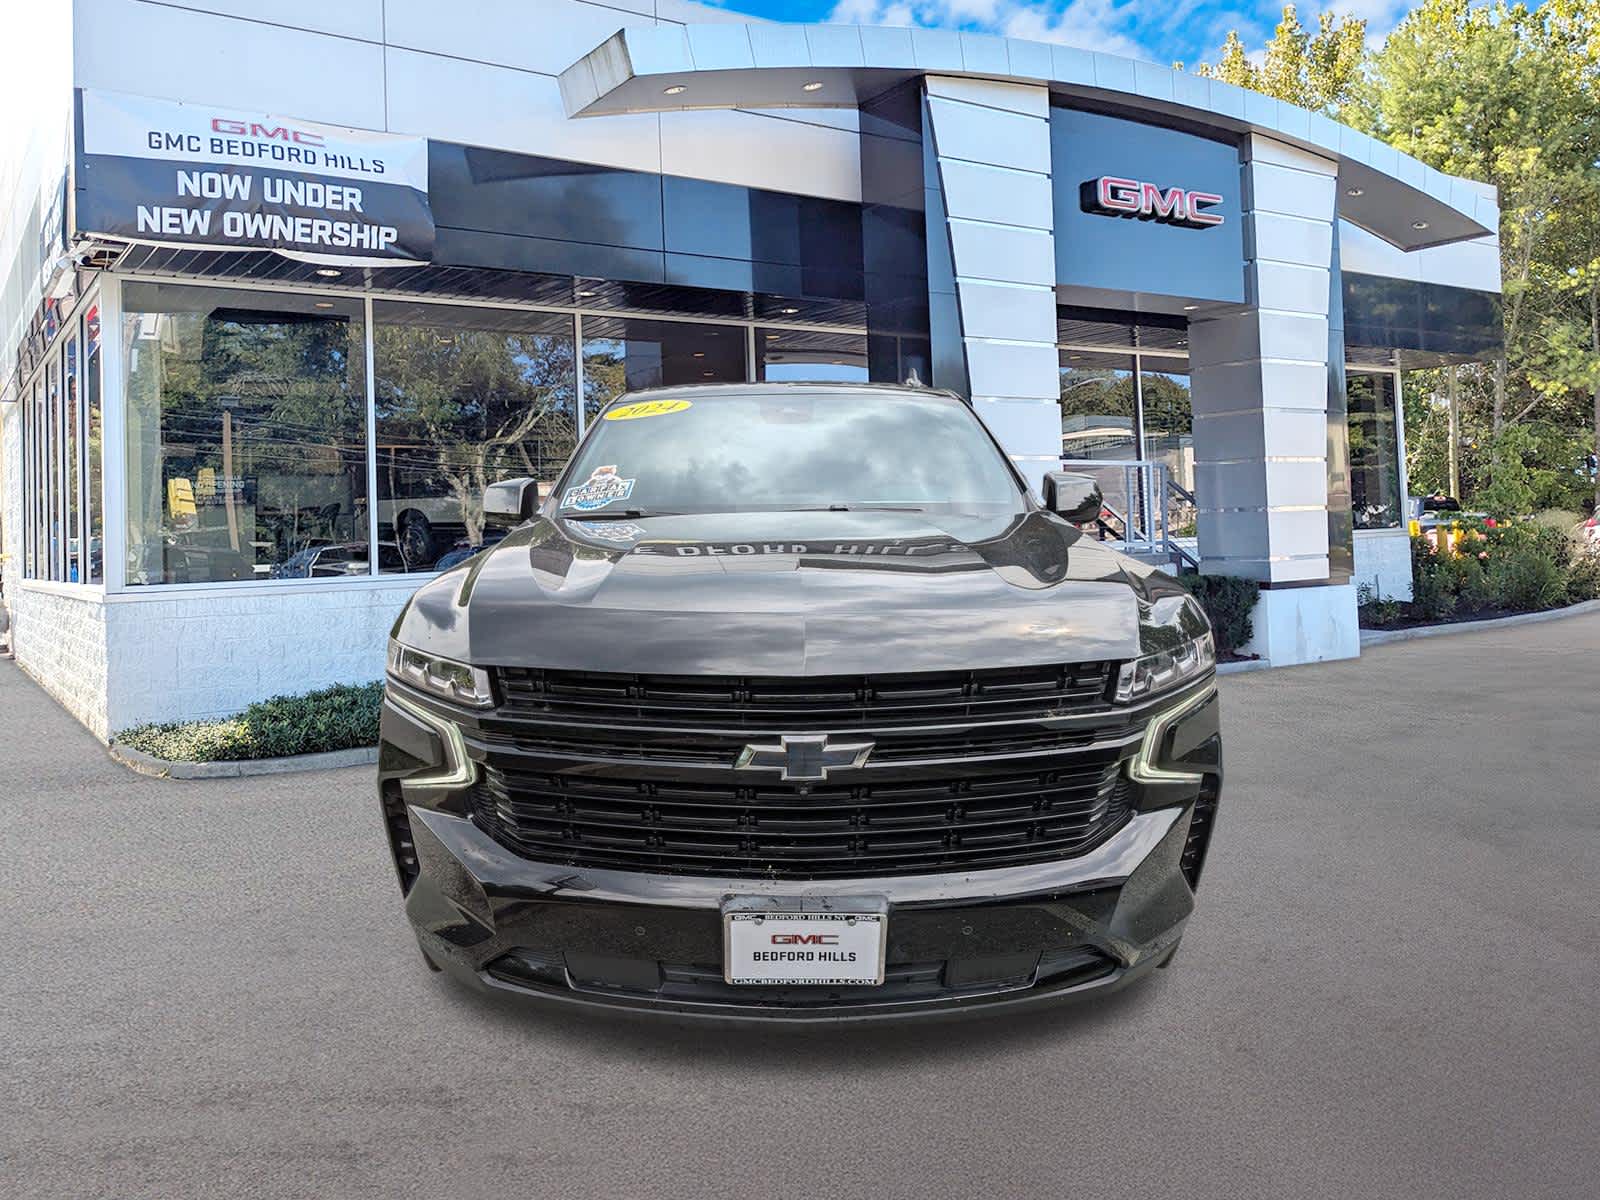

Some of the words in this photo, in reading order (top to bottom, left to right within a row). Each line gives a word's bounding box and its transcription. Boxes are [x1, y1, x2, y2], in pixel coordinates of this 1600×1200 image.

[147, 131, 201, 153] GMC
[210, 138, 317, 166] BEDFORD
[324, 152, 385, 174] HILLS
[212, 118, 326, 148] GMC
[176, 170, 253, 201] NOW
[262, 176, 364, 214] UNDER
[1097, 176, 1224, 225] GMC
[136, 205, 212, 236] NEW
[222, 210, 398, 251] OWNERSHIP
[753, 951, 815, 962] BEDFORD
[819, 951, 857, 962] HILLS
[770, 934, 840, 945] GMC
